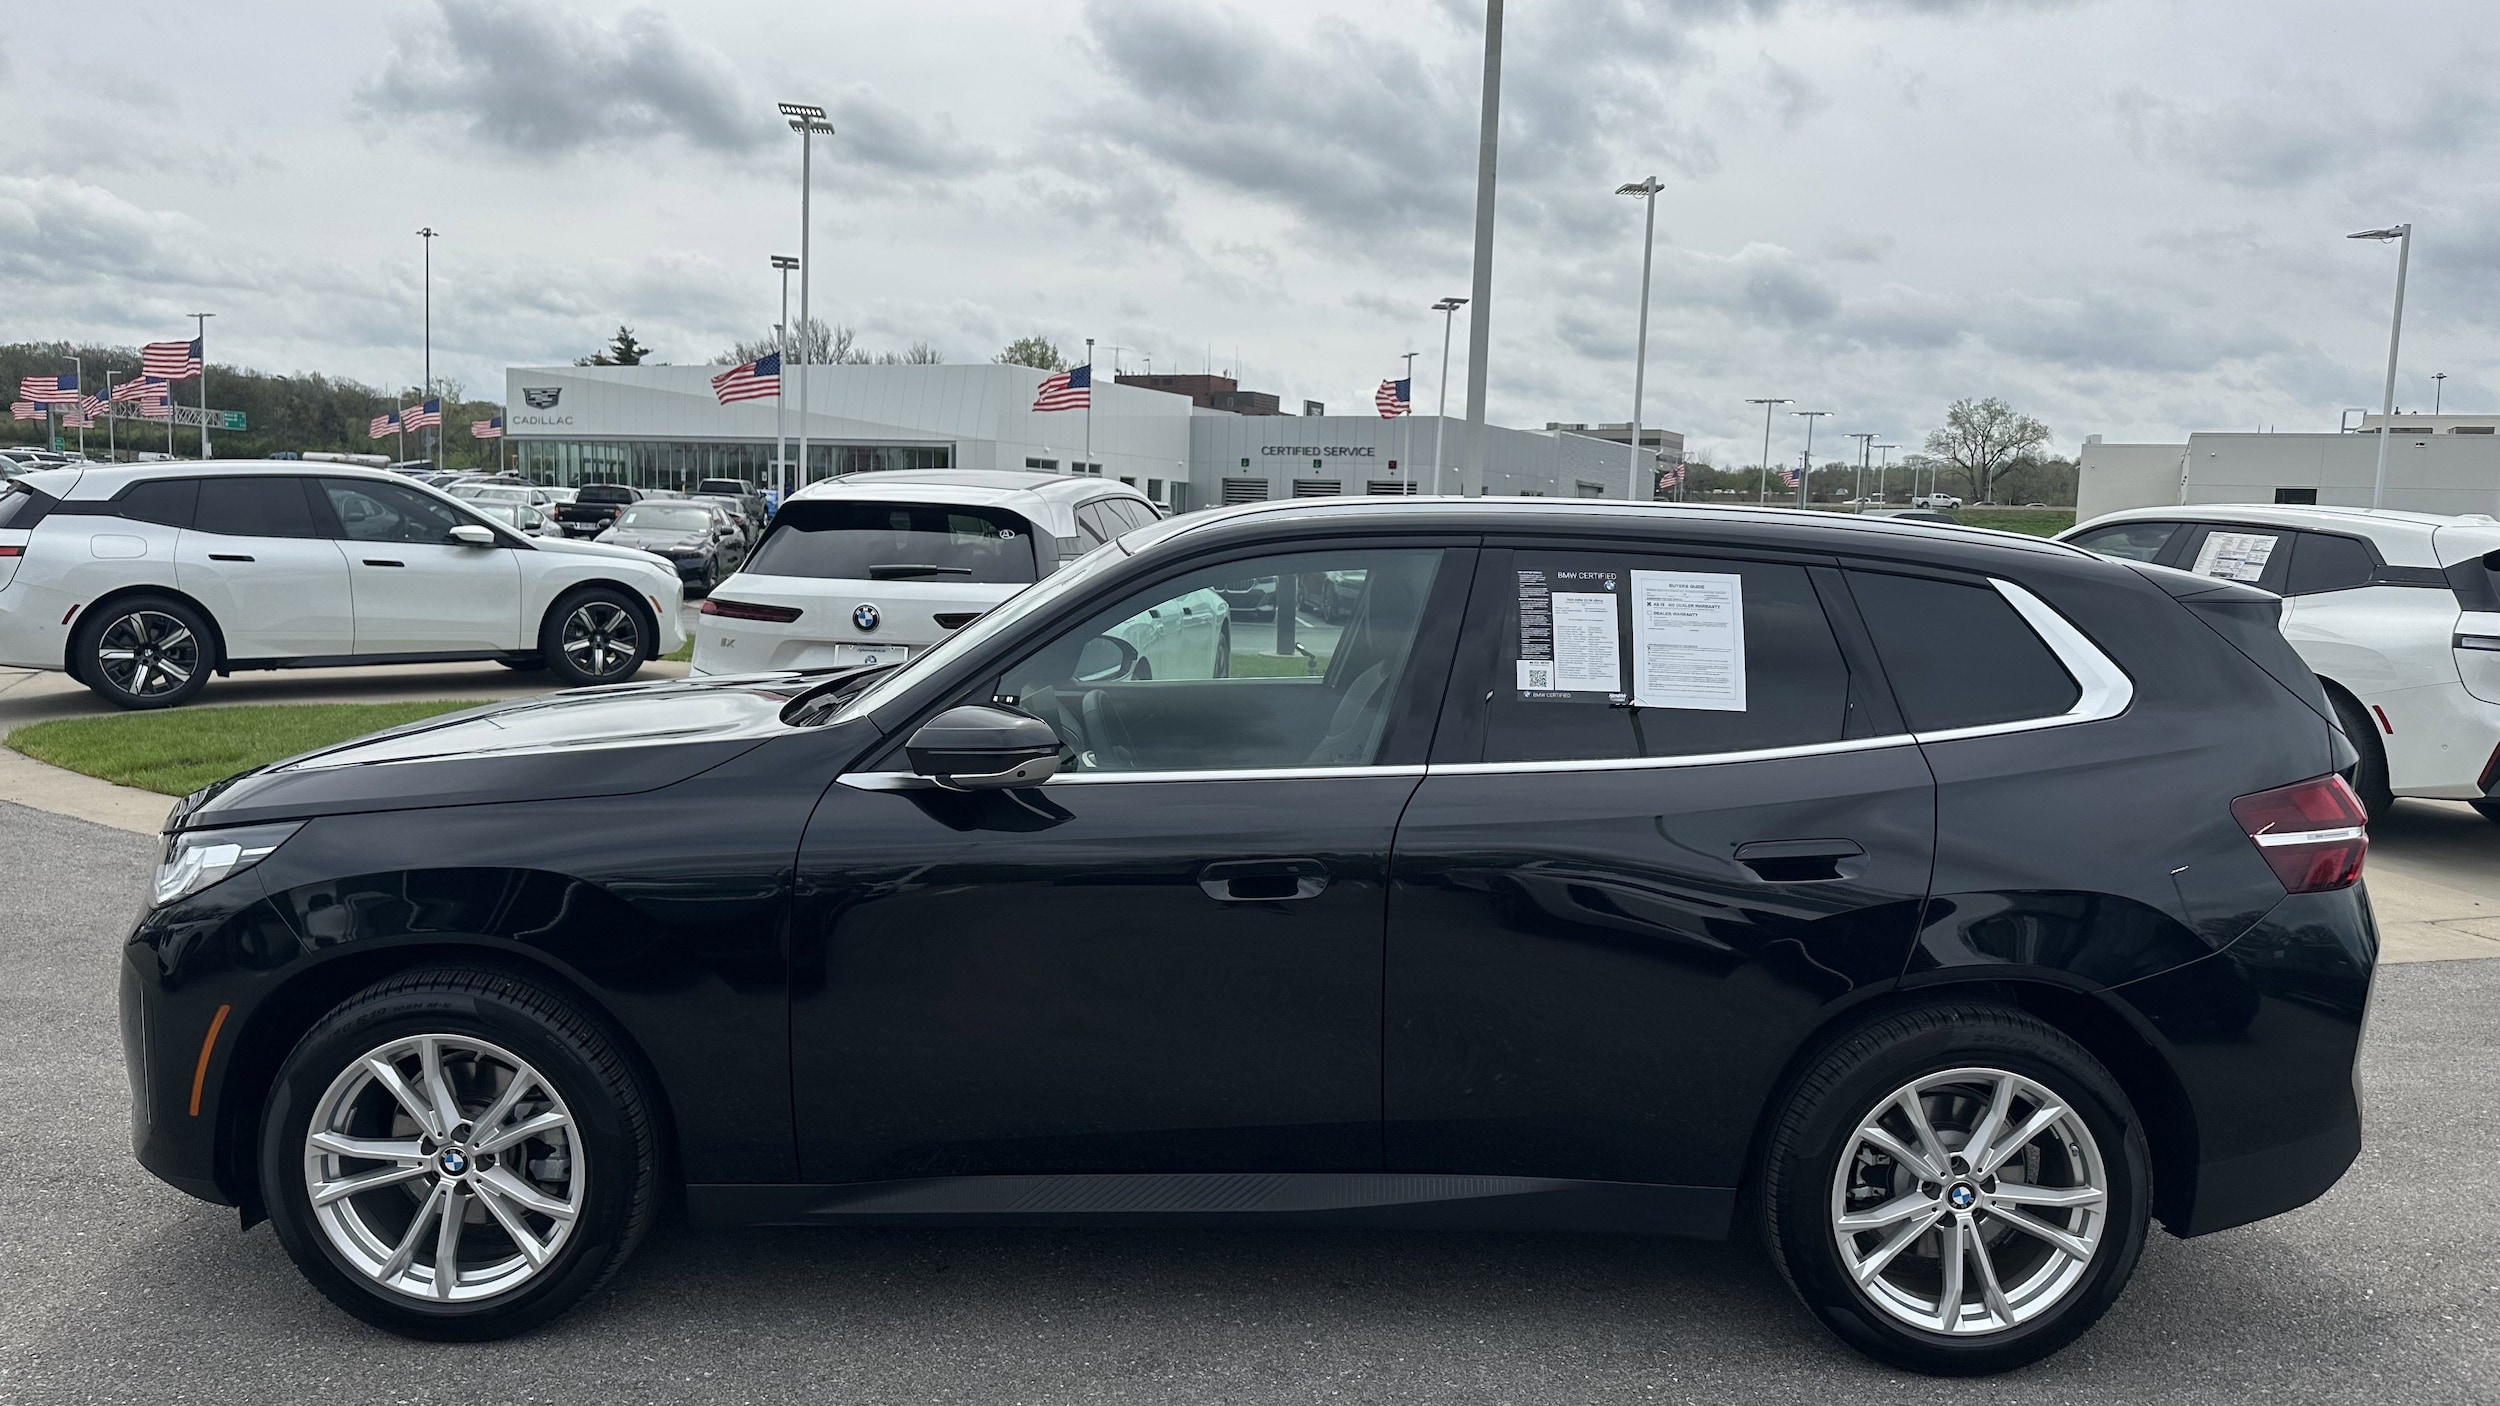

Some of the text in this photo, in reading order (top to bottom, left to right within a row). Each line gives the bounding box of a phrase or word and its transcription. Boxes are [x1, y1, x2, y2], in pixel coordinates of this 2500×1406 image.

[512, 415, 574, 425] CADILLAC
[1260, 445, 1376, 457] CERTIFIED SERVICE
[1557, 571, 1617, 580] BMW CERTIFIED
